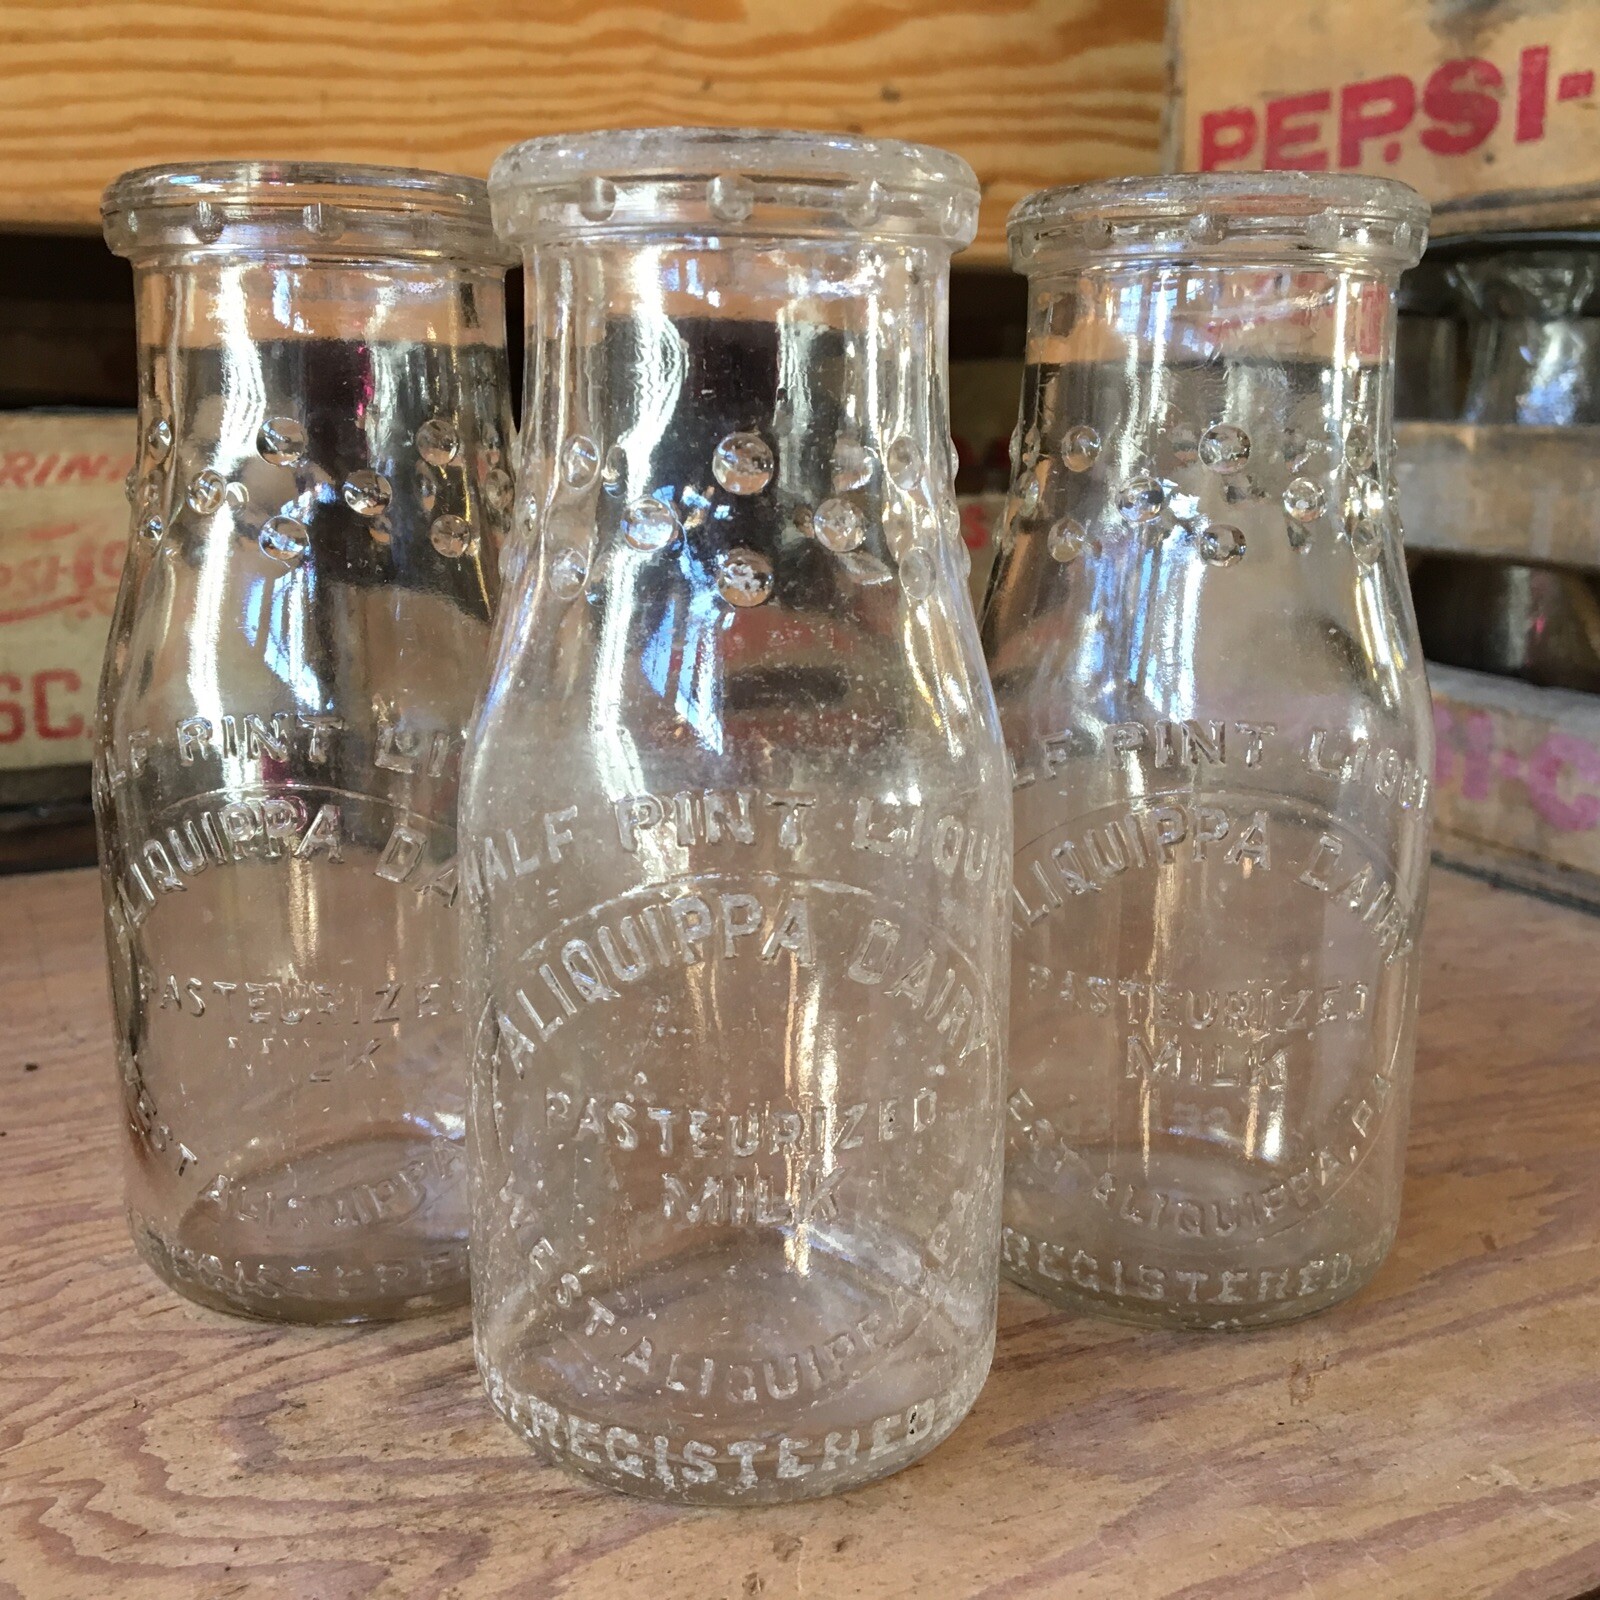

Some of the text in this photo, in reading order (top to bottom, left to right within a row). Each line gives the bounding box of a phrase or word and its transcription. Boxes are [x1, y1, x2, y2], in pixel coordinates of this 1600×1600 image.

[1100, 720, 1278, 771] PINT
[613, 787, 816, 853] PINT
[1011, 806, 1271, 938] LIQUIPPA
[497, 894, 817, 1080] ALIQUIPPA
[547, 1088, 938, 1158] PASTEURIZED
[661, 1166, 846, 1225] MILK
[1002, 1226, 1352, 1305] REGISTERED
[527, 1397, 936, 1490] REGISTERED
